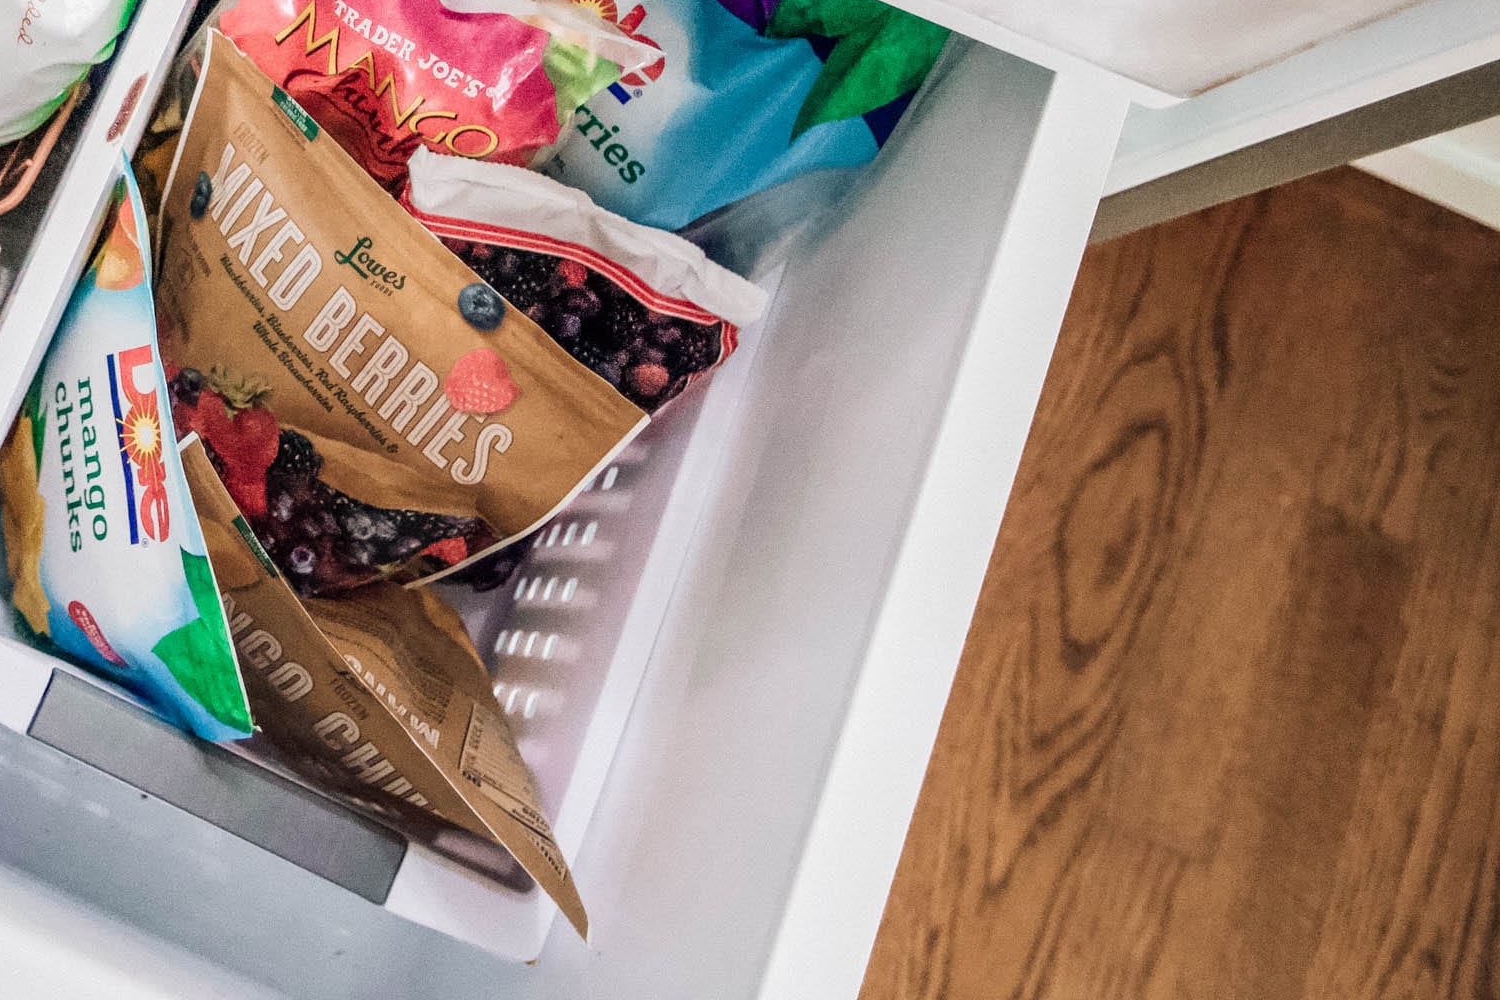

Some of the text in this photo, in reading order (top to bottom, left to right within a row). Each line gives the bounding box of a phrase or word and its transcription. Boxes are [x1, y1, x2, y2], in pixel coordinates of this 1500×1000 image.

[417, 51, 486, 98] JOE'S
[208, 141, 324, 312] MIXED
[302, 285, 515, 485] BERRIES
[334, 236, 408, 291] Lowes
[54, 381, 84, 554] chunks
[77, 376, 109, 542] mango
[118, 344, 171, 543] Dole
